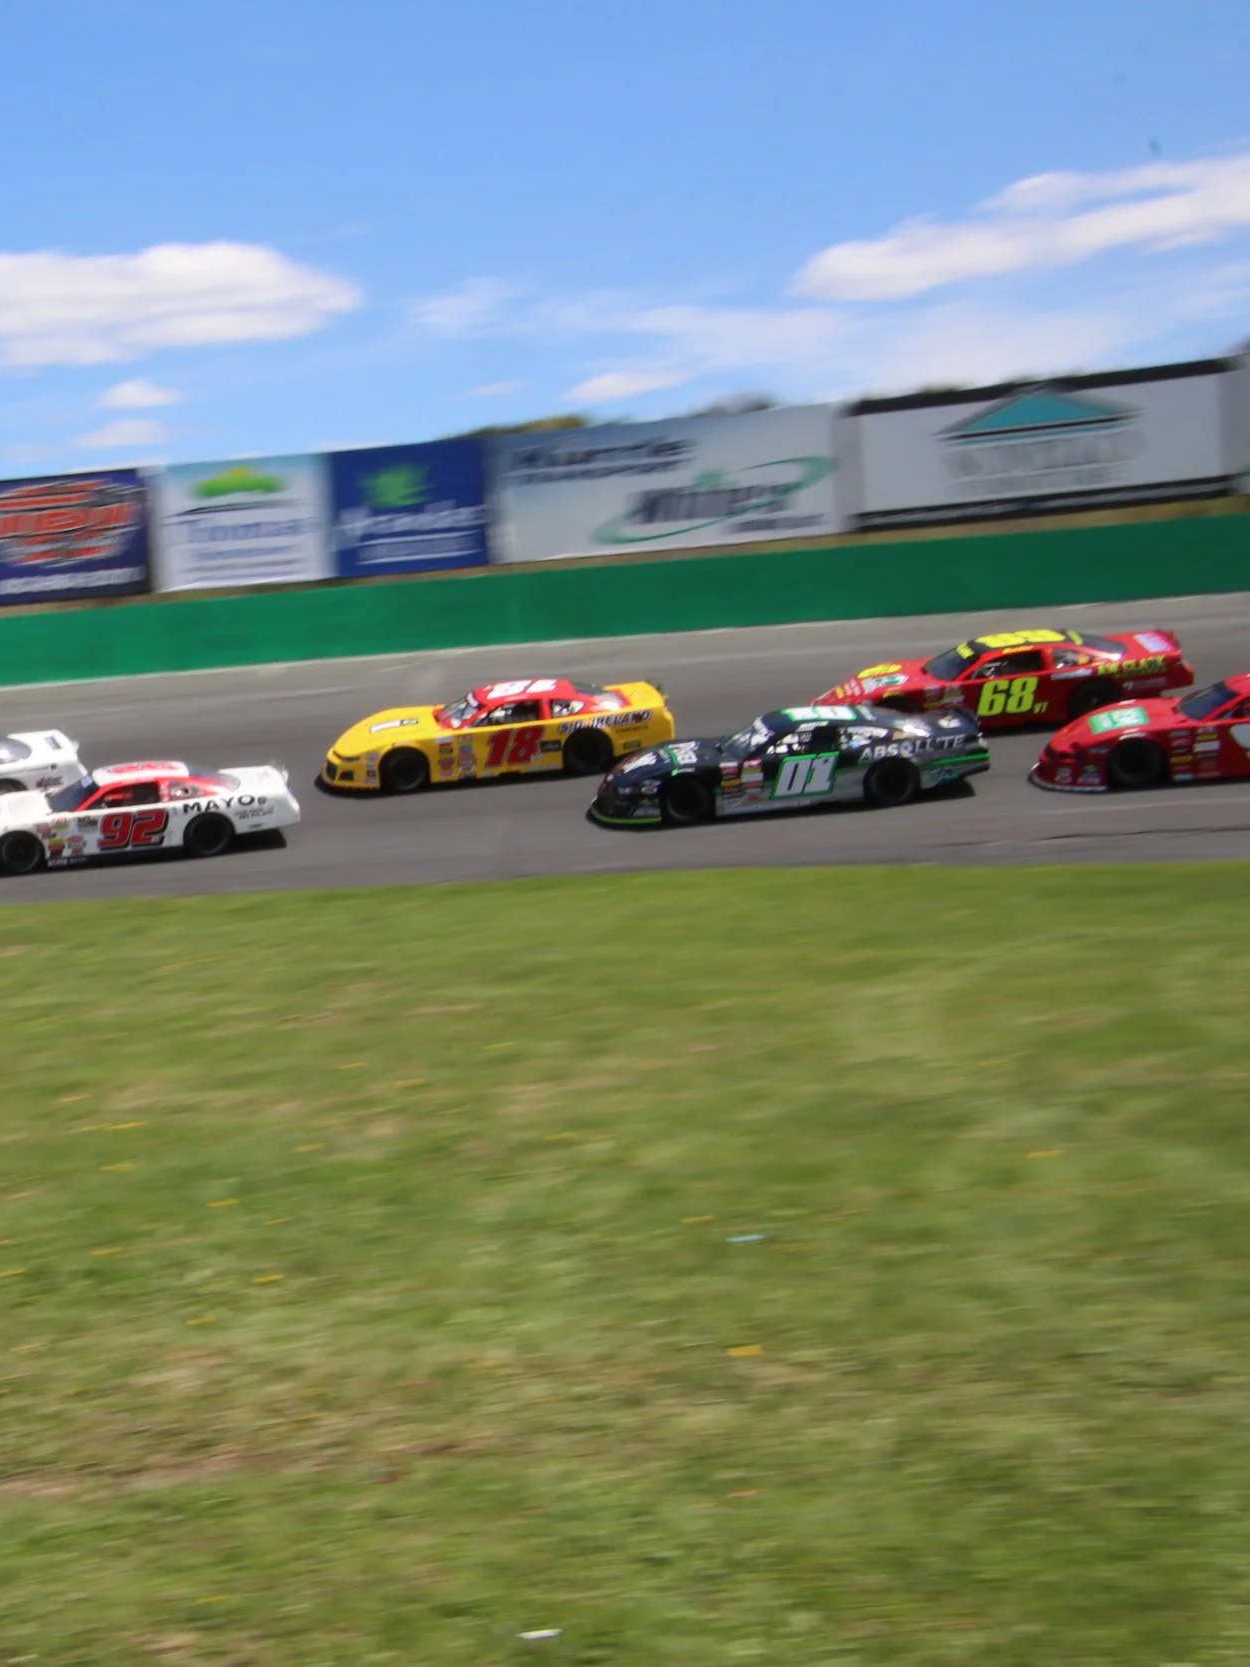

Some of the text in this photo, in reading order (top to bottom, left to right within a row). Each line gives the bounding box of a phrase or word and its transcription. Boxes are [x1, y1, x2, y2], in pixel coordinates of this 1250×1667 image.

[977, 677, 1038, 716] 68
[588, 709, 654, 729] IRELAND
[486, 726, 546, 768] 18
[770, 752, 841, 799] 01
[97, 809, 170, 849] 92
